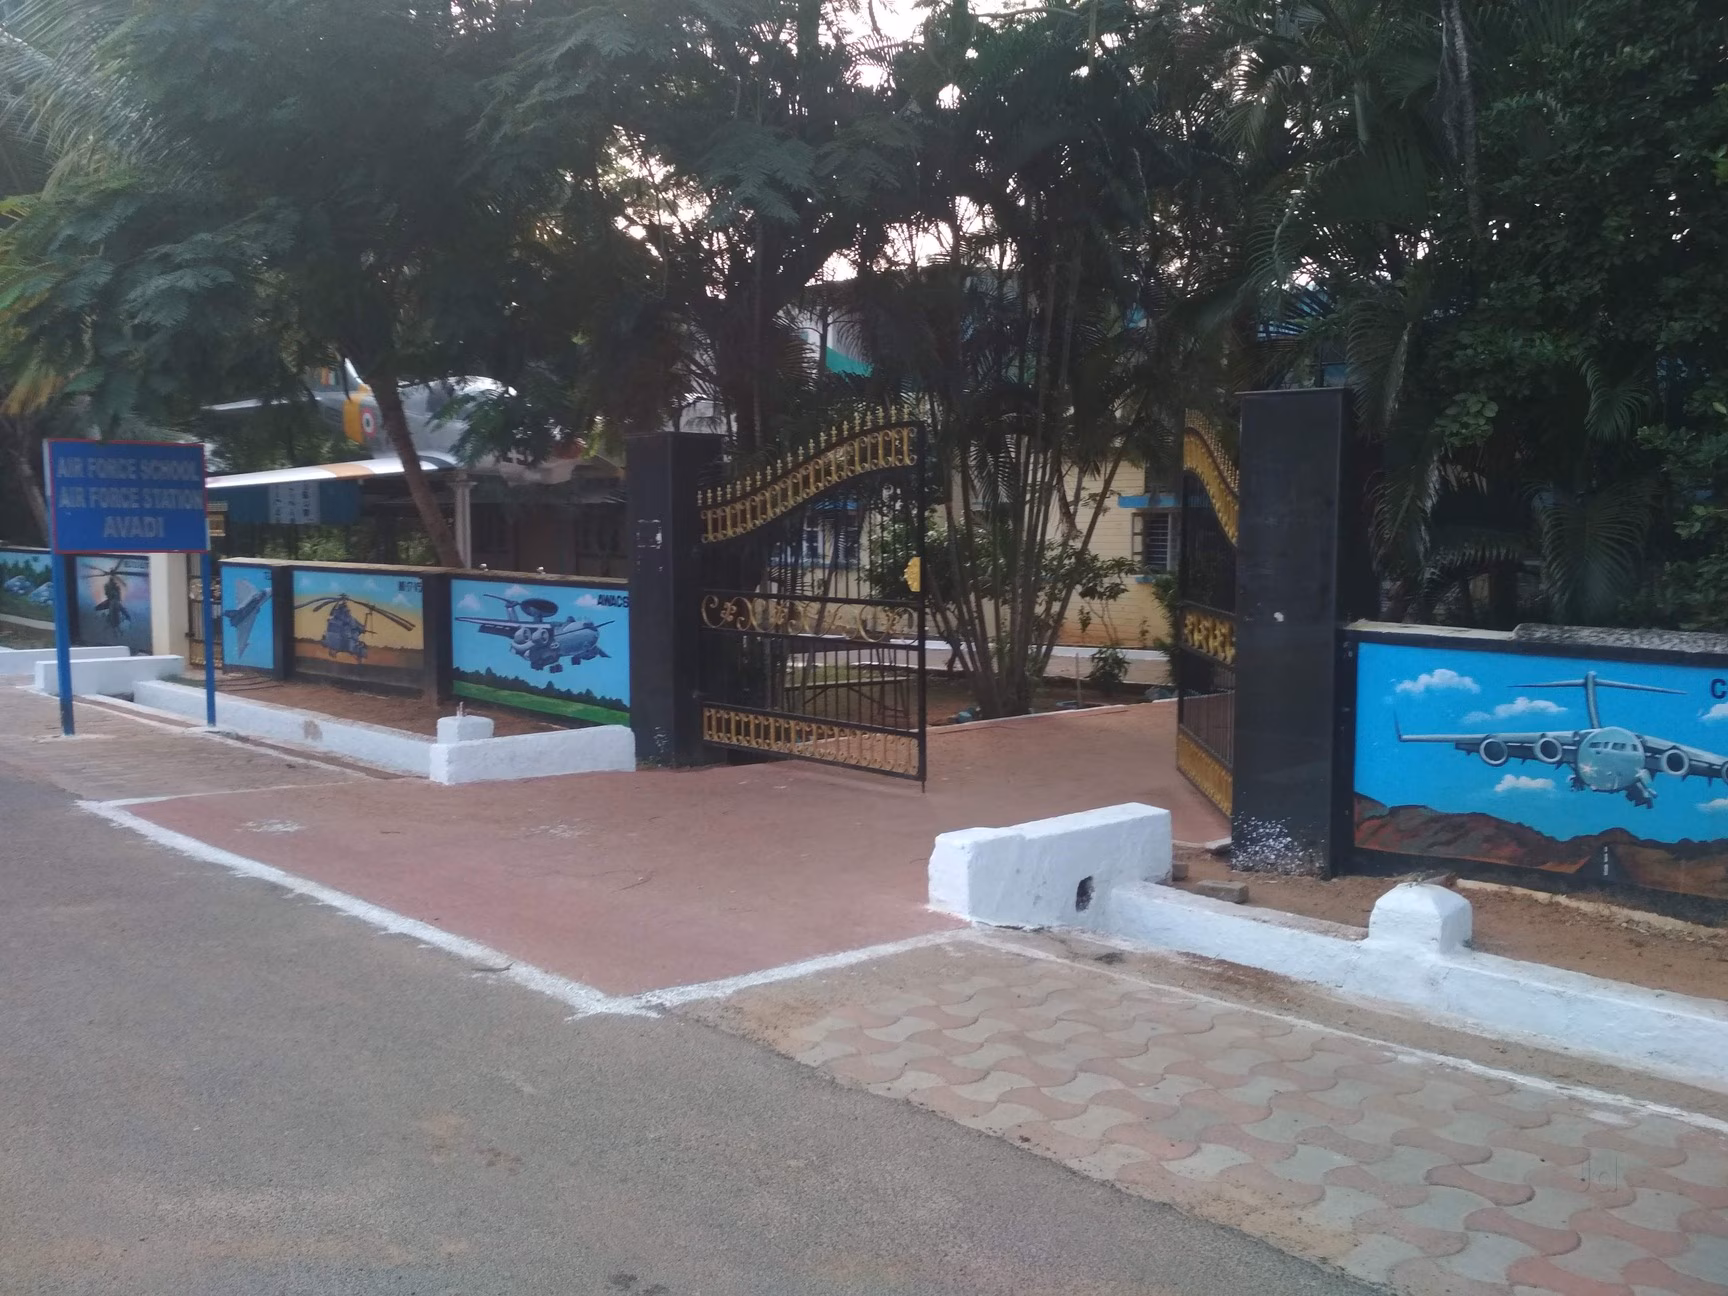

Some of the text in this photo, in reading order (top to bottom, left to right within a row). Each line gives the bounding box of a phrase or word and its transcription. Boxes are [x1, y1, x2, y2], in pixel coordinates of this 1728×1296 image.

[57, 456, 201, 482] AIR FORCE SCHOOL
[58, 486, 205, 510] AIR FORCE STATION
[103, 516, 166, 538] AVADI
[597, 594, 630, 608] AWACS
